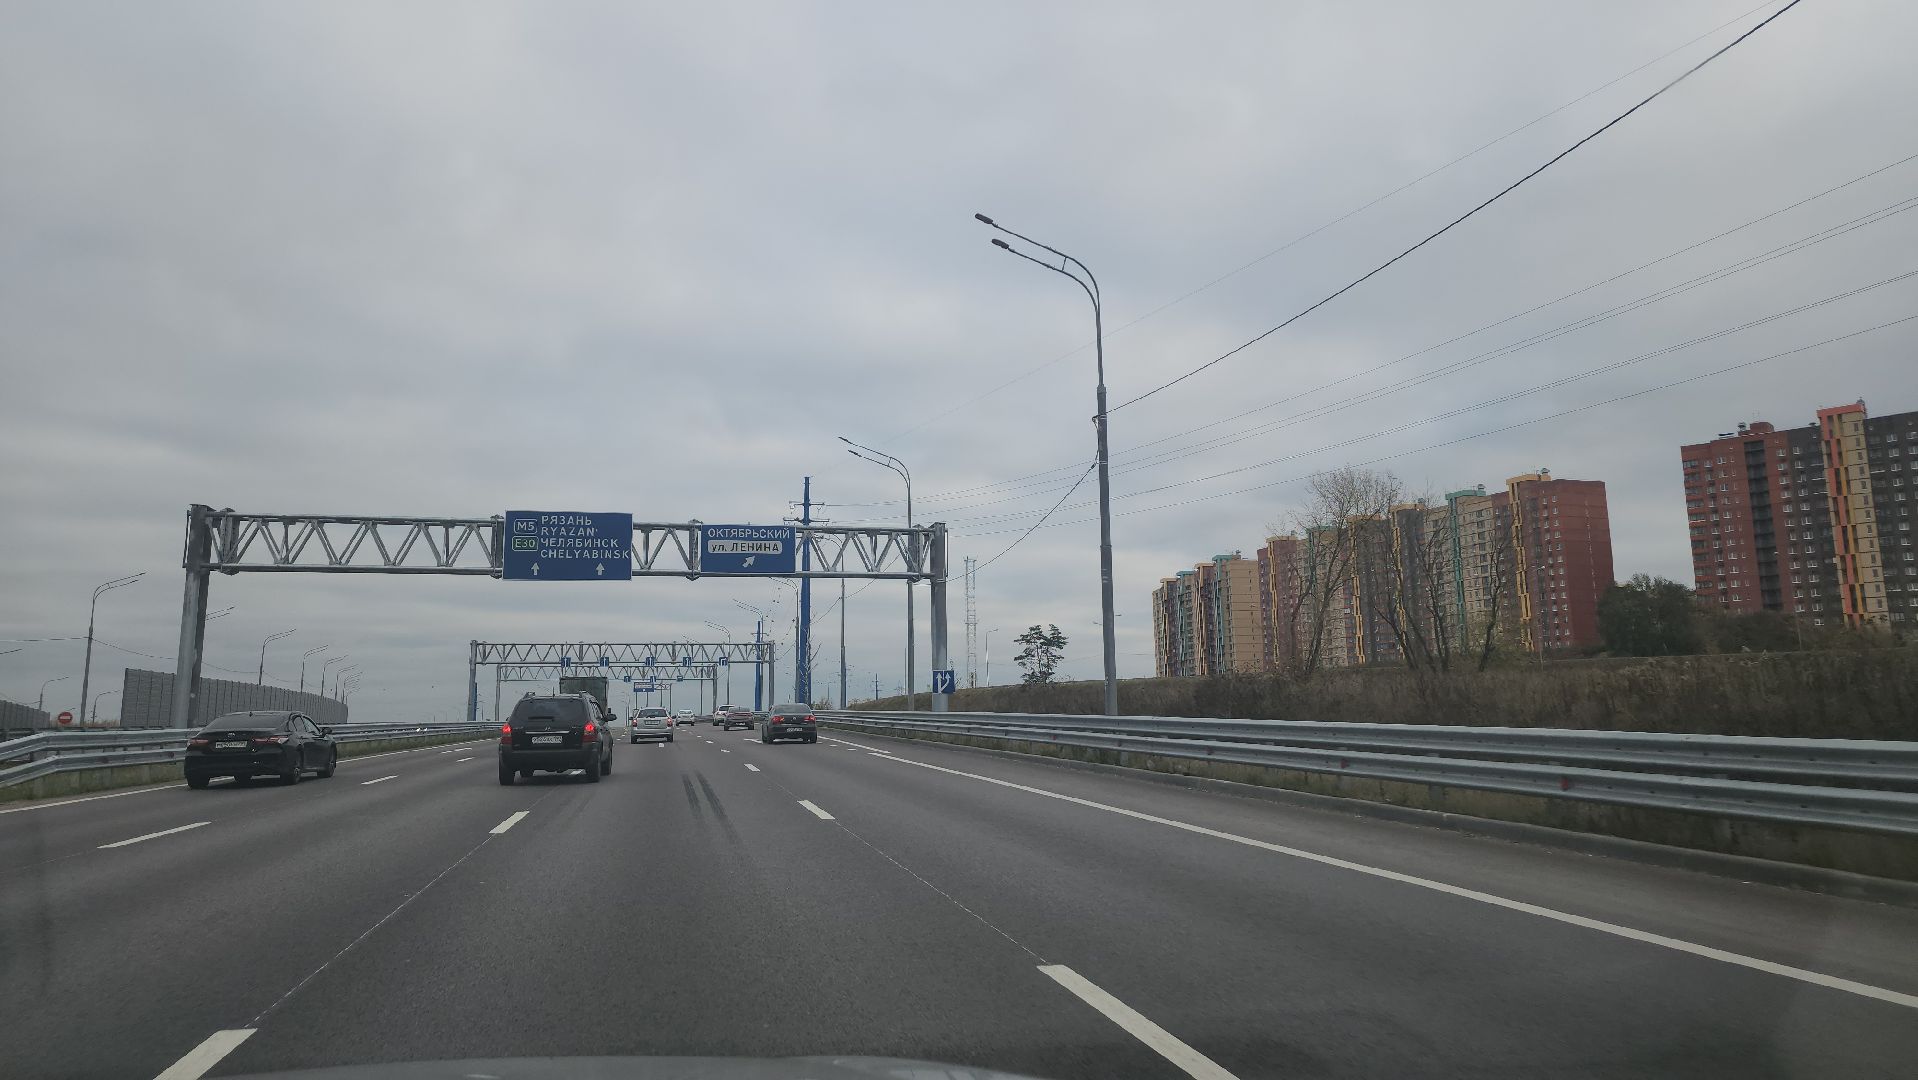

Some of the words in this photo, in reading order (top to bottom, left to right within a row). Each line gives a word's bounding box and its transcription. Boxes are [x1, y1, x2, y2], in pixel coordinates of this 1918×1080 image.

[541, 515, 592, 526] РЯЗАНЬ
[707, 527, 790, 539] ОКТЯБРЬСКИЙ
[515, 539, 536, 548] E30
[540, 537, 619, 548] ЧЕЛЯБИНСК
[711, 543, 727, 552] ул.
[730, 542, 779, 552] ЛЕНИНА
[540, 549, 630, 559] CHELYABINSK
